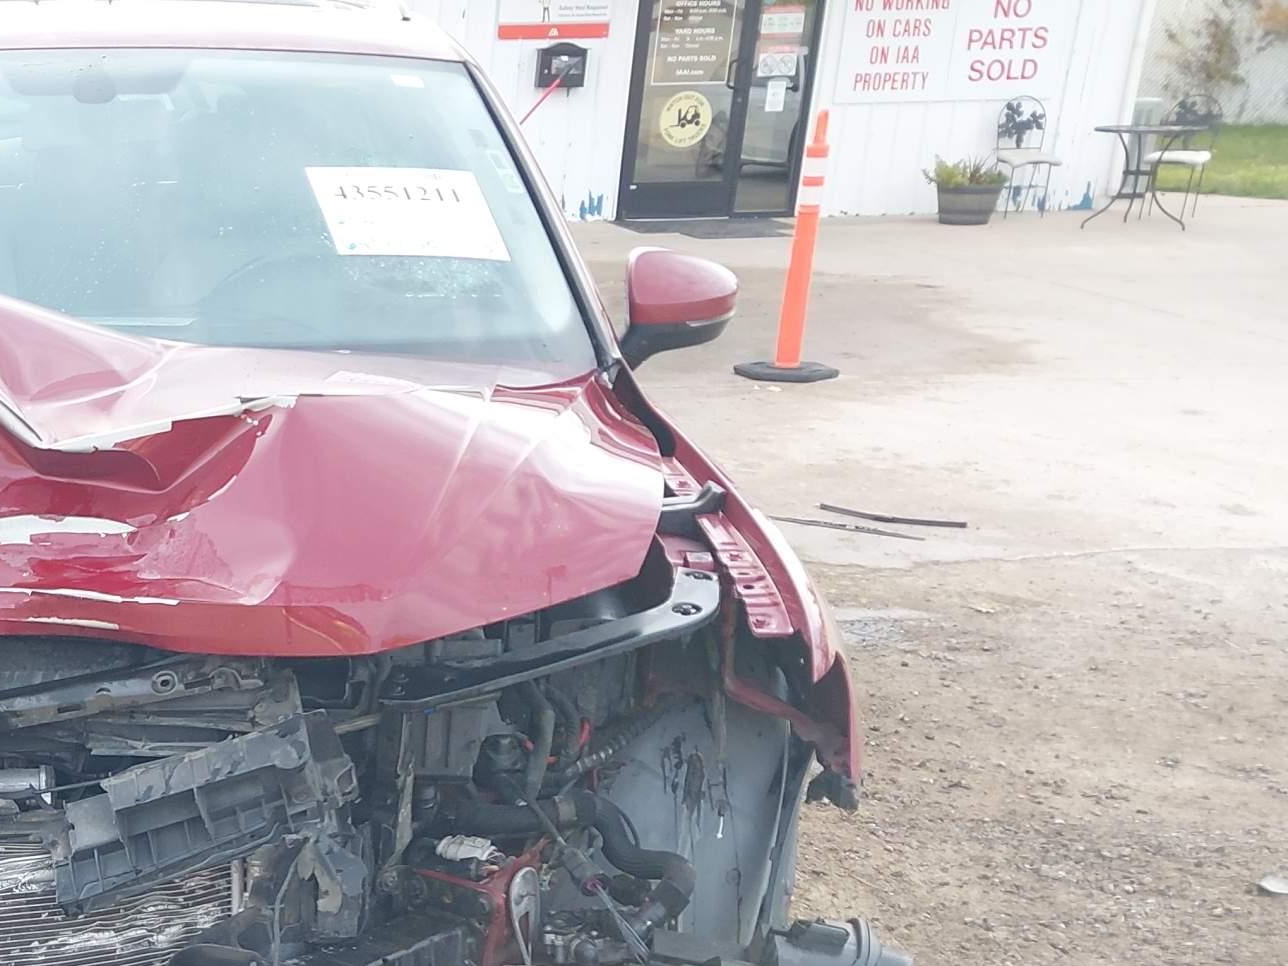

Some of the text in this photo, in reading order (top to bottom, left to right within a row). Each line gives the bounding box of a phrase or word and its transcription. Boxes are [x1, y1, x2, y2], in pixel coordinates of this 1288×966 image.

[993, 0, 1033, 19] NO
[865, 18, 932, 38] ON CARS
[967, 26, 1049, 51] PARTS
[869, 45, 920, 64] ON IAA
[968, 58, 1038, 82] SOLD
[853, 72, 929, 91] PROPERTY
[334, 185, 461, 202] 43551211
